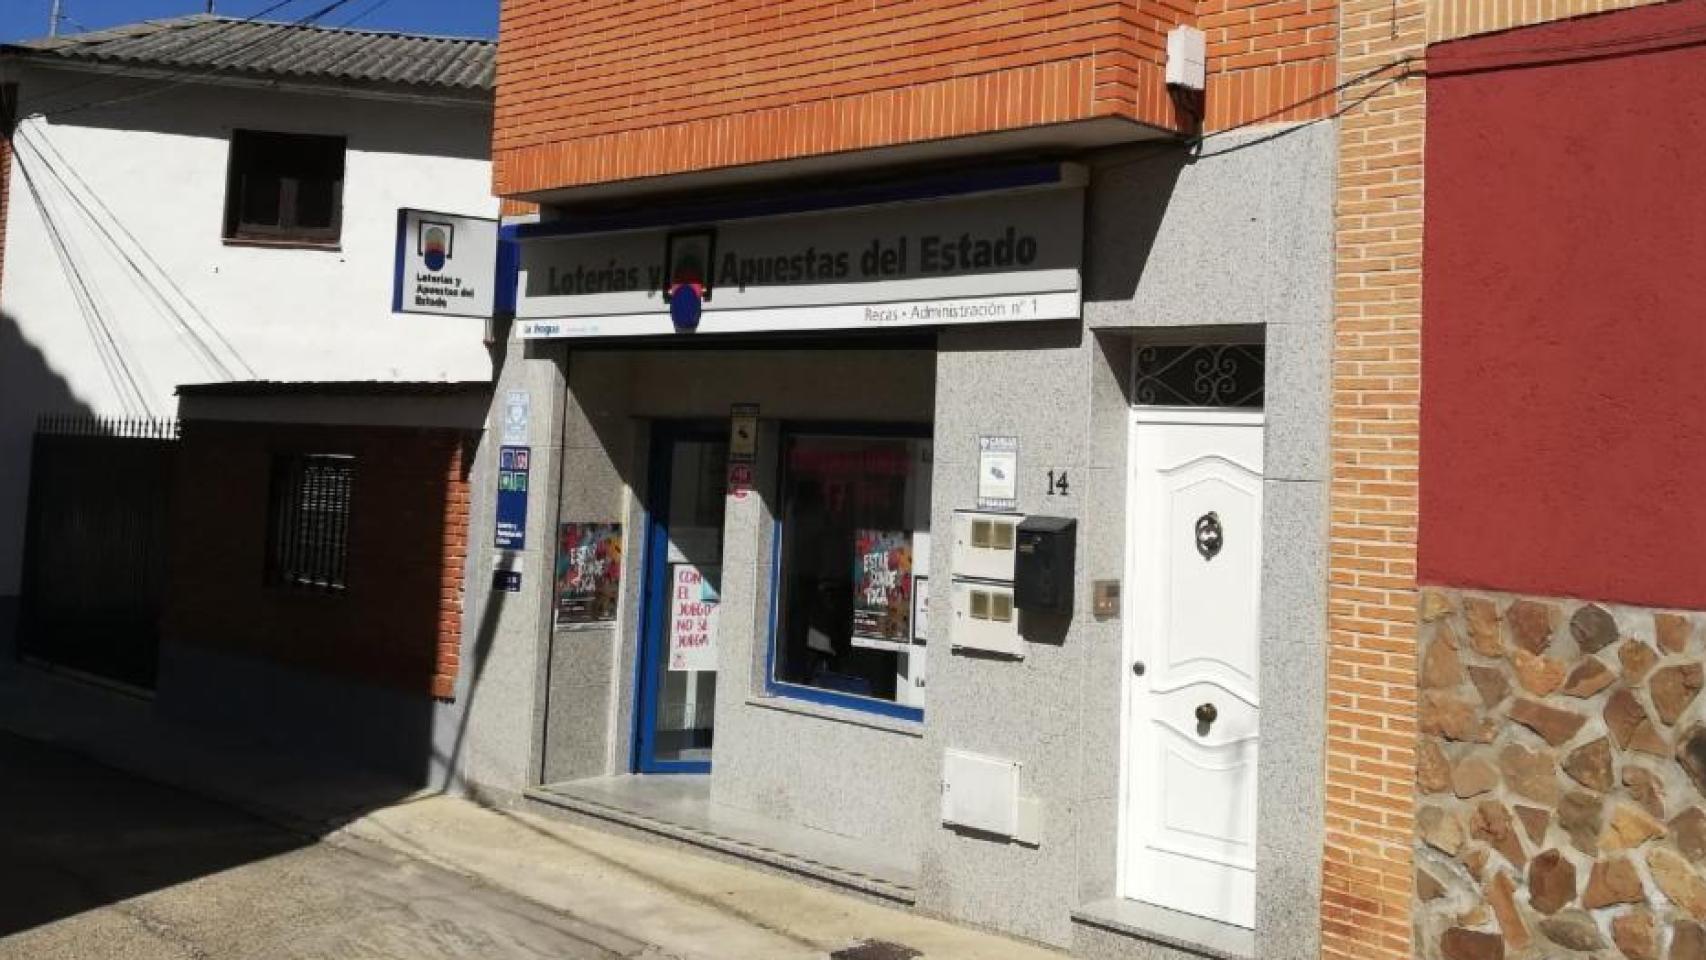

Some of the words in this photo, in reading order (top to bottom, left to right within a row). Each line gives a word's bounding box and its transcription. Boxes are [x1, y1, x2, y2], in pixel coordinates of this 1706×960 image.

[548, 257, 639, 295] Loterías
[647, 265, 661, 299] y
[721, 246, 849, 293] Apuestas
[860, 236, 907, 278] del
[920, 226, 1037, 272] Estado
[416, 284, 458, 296] Apuestas
[460, 287, 475, 298] del
[415, 295, 448, 308] Estado
[864, 307, 899, 321] Recas
[911, 301, 1005, 320] Administración
[1046, 469, 1070, 496] 14
[679, 571, 702, 585] CON
[678, 586, 689, 600] EL
[678, 602, 711, 617] JUEGO
[677, 619, 693, 632] NO
[675, 634, 709, 649] JUEGA
